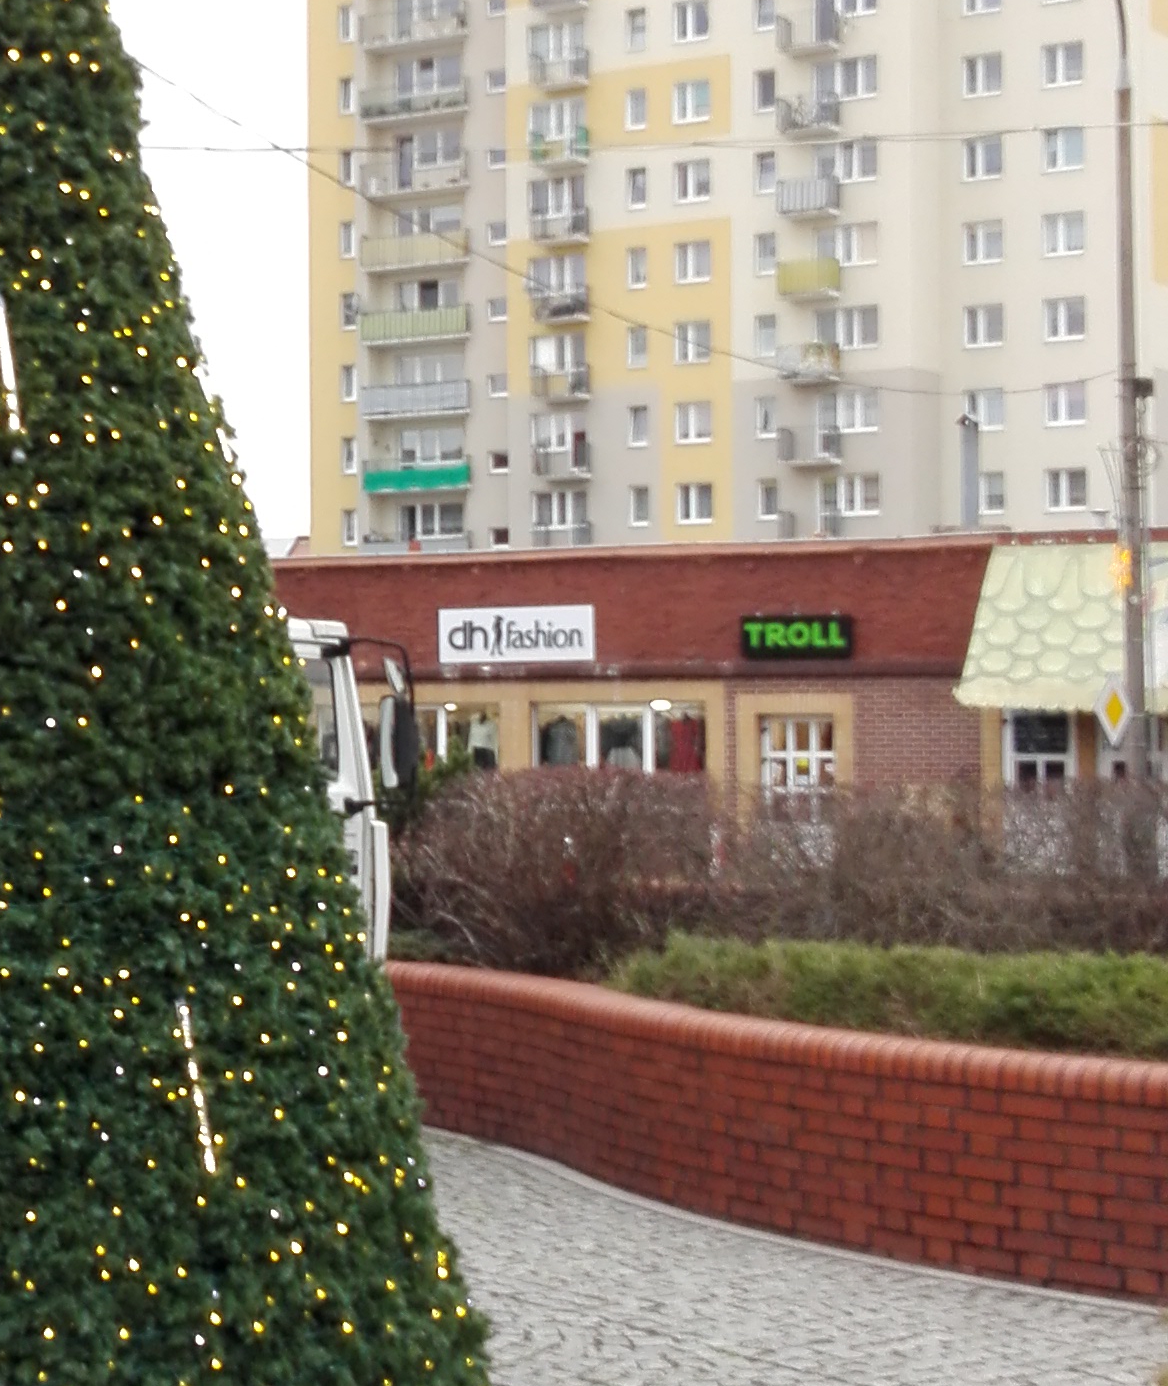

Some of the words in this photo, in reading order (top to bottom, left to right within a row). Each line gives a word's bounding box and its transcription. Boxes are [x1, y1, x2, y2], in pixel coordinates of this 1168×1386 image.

[448, 620, 489, 650] dh
[505, 619, 583, 649] fashion
[743, 621, 847, 648] TROLL
